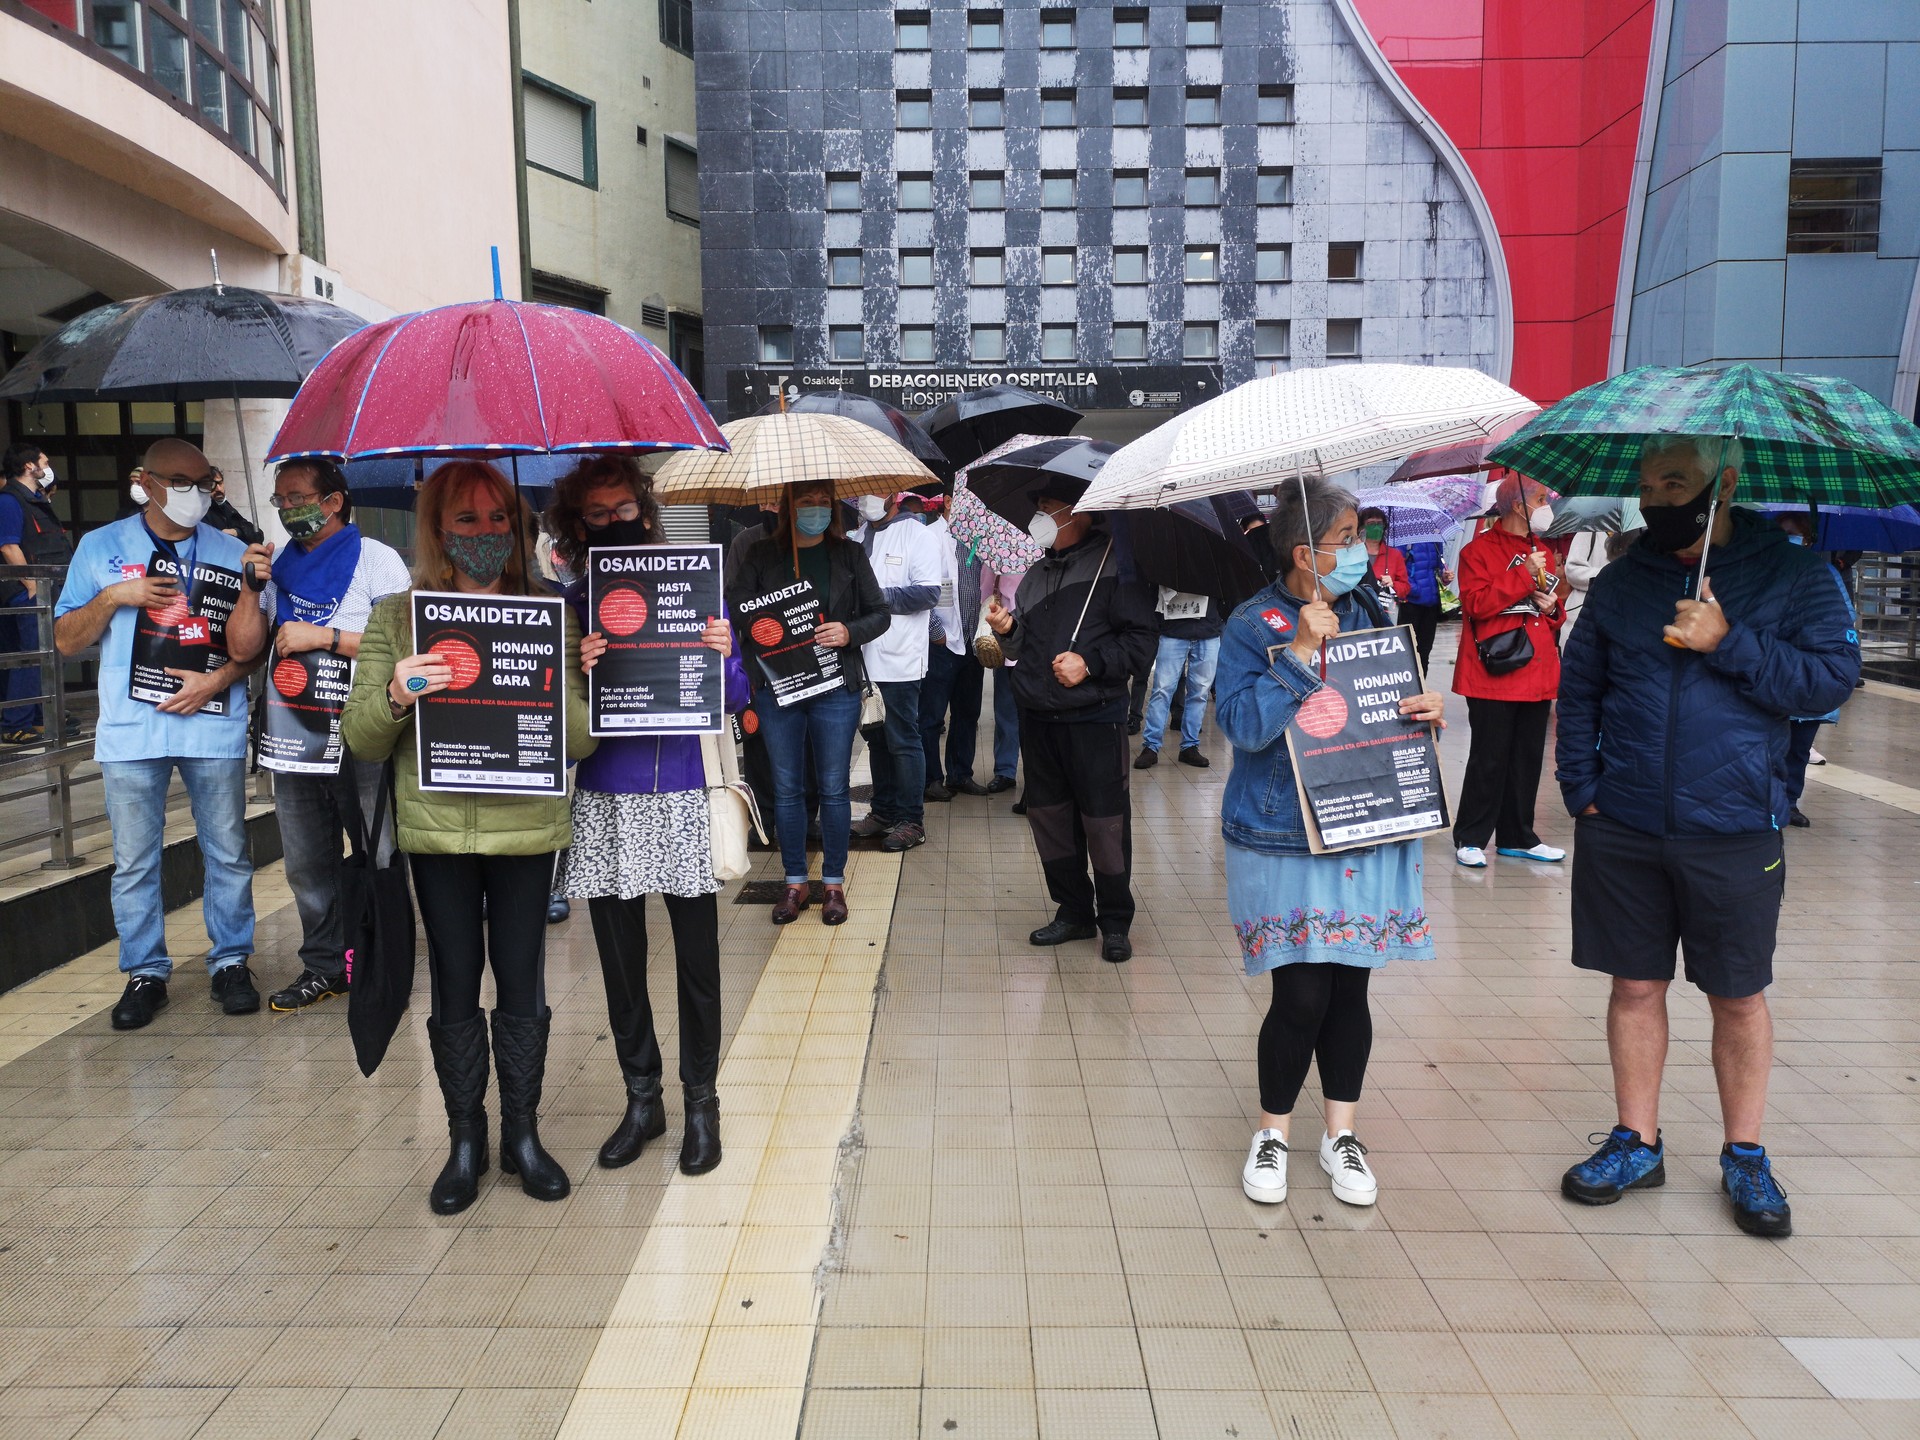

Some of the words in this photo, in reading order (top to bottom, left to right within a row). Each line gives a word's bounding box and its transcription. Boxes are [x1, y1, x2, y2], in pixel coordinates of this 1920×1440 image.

[869, 373, 1002, 388] DEBAGOIENEKO
[1005, 372, 1098, 387] OSPITALEA
[901, 391, 957, 406] HOSPIT
[599, 555, 711, 572] OSAKIDETZA
[155, 558, 242, 592] OSAKIDETZA
[657, 582, 692, 593] HASTA
[657, 593, 683, 607] AQUÍ
[739, 580, 813, 613] OSAKIDETZA
[199, 607, 229, 622] HELDU
[424, 603, 552, 626] OSAKIDETZA
[657, 609, 697, 620] HEMOS
[783, 599, 820, 618] HONAINO
[787, 612, 815, 627] HELDU
[207, 621, 223, 634] RA
[657, 622, 706, 633] LLEGADO
[791, 622, 815, 636] GARA
[492, 641, 553, 655] HONAINO
[1308, 636, 1406, 668] AKIDETZA
[318, 657, 348, 670] HASTA
[492, 658, 537, 671] HELDU
[316, 668, 341, 679] AQUÍ
[492, 674, 530, 687] GARA
[1353, 670, 1413, 691] HONAINO
[315, 680, 350, 692] HEMOS
[314, 690, 350, 702] LLEGAD
[447, 697, 469, 705] EGINDA
[600, 694, 622, 702] pública
[1357, 689, 1401, 708] HELDU
[1361, 708, 1399, 725] GARA
[517, 733, 543, 741] IRAILAK
[273, 748, 299, 757] derechos
[430, 741, 467, 750] Kalitatezko
[468, 743, 491, 751] osasun
[1303, 748, 1323, 758] LEHER
[1323, 745, 1345, 755] EGINDA
[1356, 741, 1370, 749] GIZA
[1392, 747, 1417, 757] IRAILAK
[430, 749, 469, 758] publikoaren
[482, 751, 510, 760] langileen
[1396, 769, 1421, 779] IRAILAK
[1314, 795, 1351, 807] Kalitatezko
[1351, 792, 1374, 801] osasun
[1316, 803, 1354, 817] publikoaren
[1366, 796, 1394, 808] langileen
[1318, 813, 1355, 824] eskubideen
[1355, 809, 1369, 818] alde
